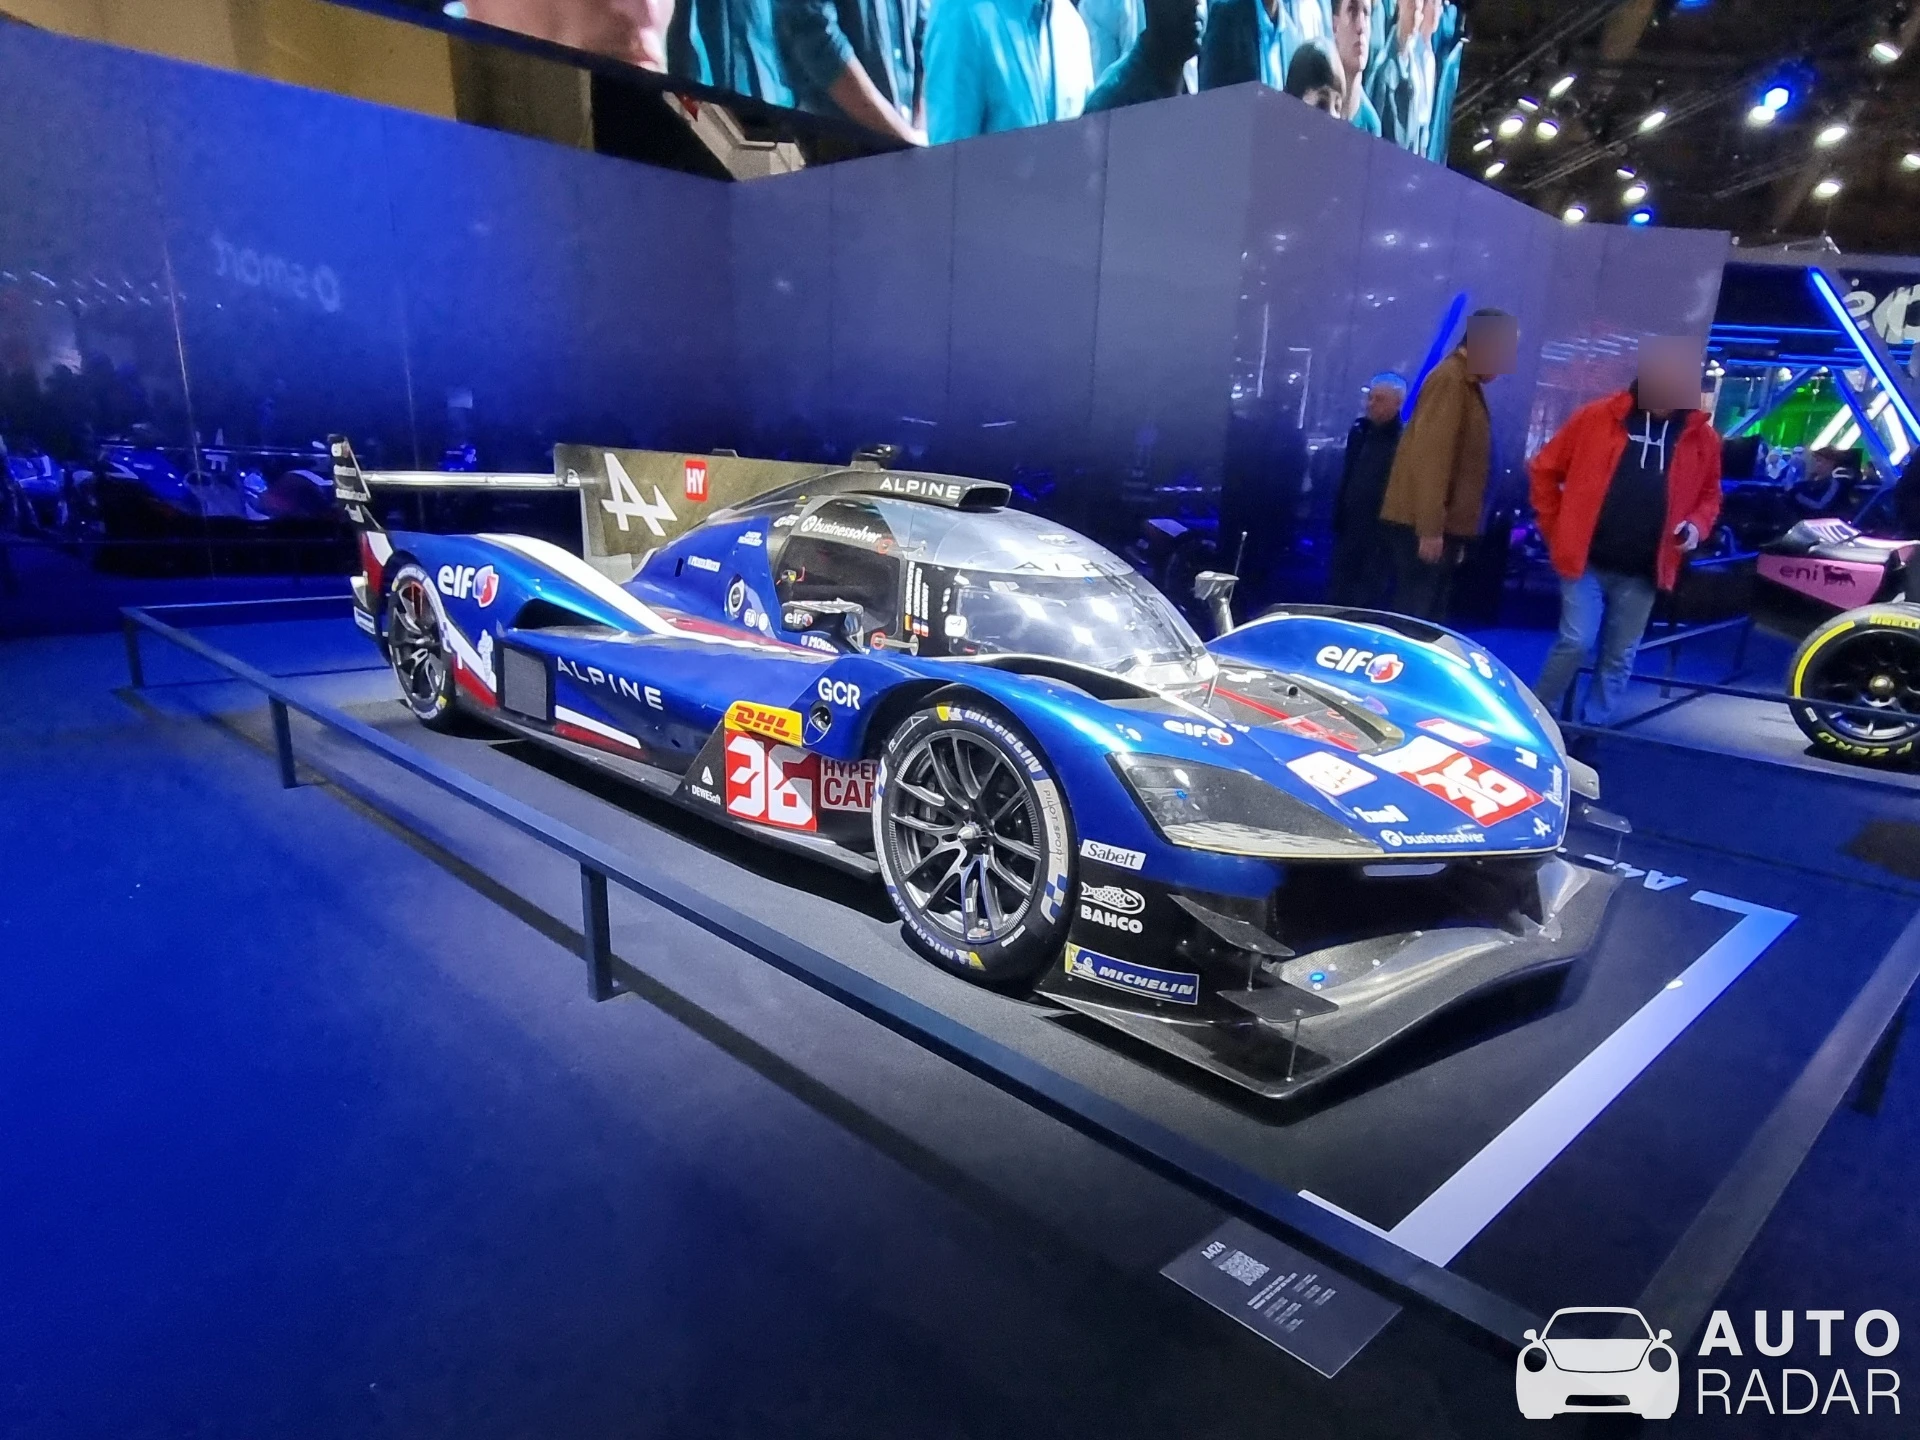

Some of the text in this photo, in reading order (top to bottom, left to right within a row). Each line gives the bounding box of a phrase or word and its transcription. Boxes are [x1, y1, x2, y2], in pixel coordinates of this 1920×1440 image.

[685, 468, 706, 495] HY
[880, 477, 962, 499] ALPINE
[814, 516, 882, 543] businessolver
[437, 565, 476, 599] elf
[1778, 565, 1819, 581] eni
[784, 613, 803, 625] elf
[1316, 645, 1373, 675] elf
[557, 656, 663, 710] ALPINE
[818, 677, 860, 710] GCR
[734, 704, 790, 737] DHL
[1163, 719, 1207, 738] elf
[964, 709, 1043, 774] MICHELIN
[727, 735, 813, 826] 36
[1043, 789, 1063, 864] PILOT SPORT
[1398, 831, 1485, 846] businessolver
[1087, 843, 1138, 867] Sabelt
[891, 892, 955, 961] MICHELIN
[1080, 906, 1143, 934] BAHCO
[1099, 966, 1194, 995] MICHELIN
